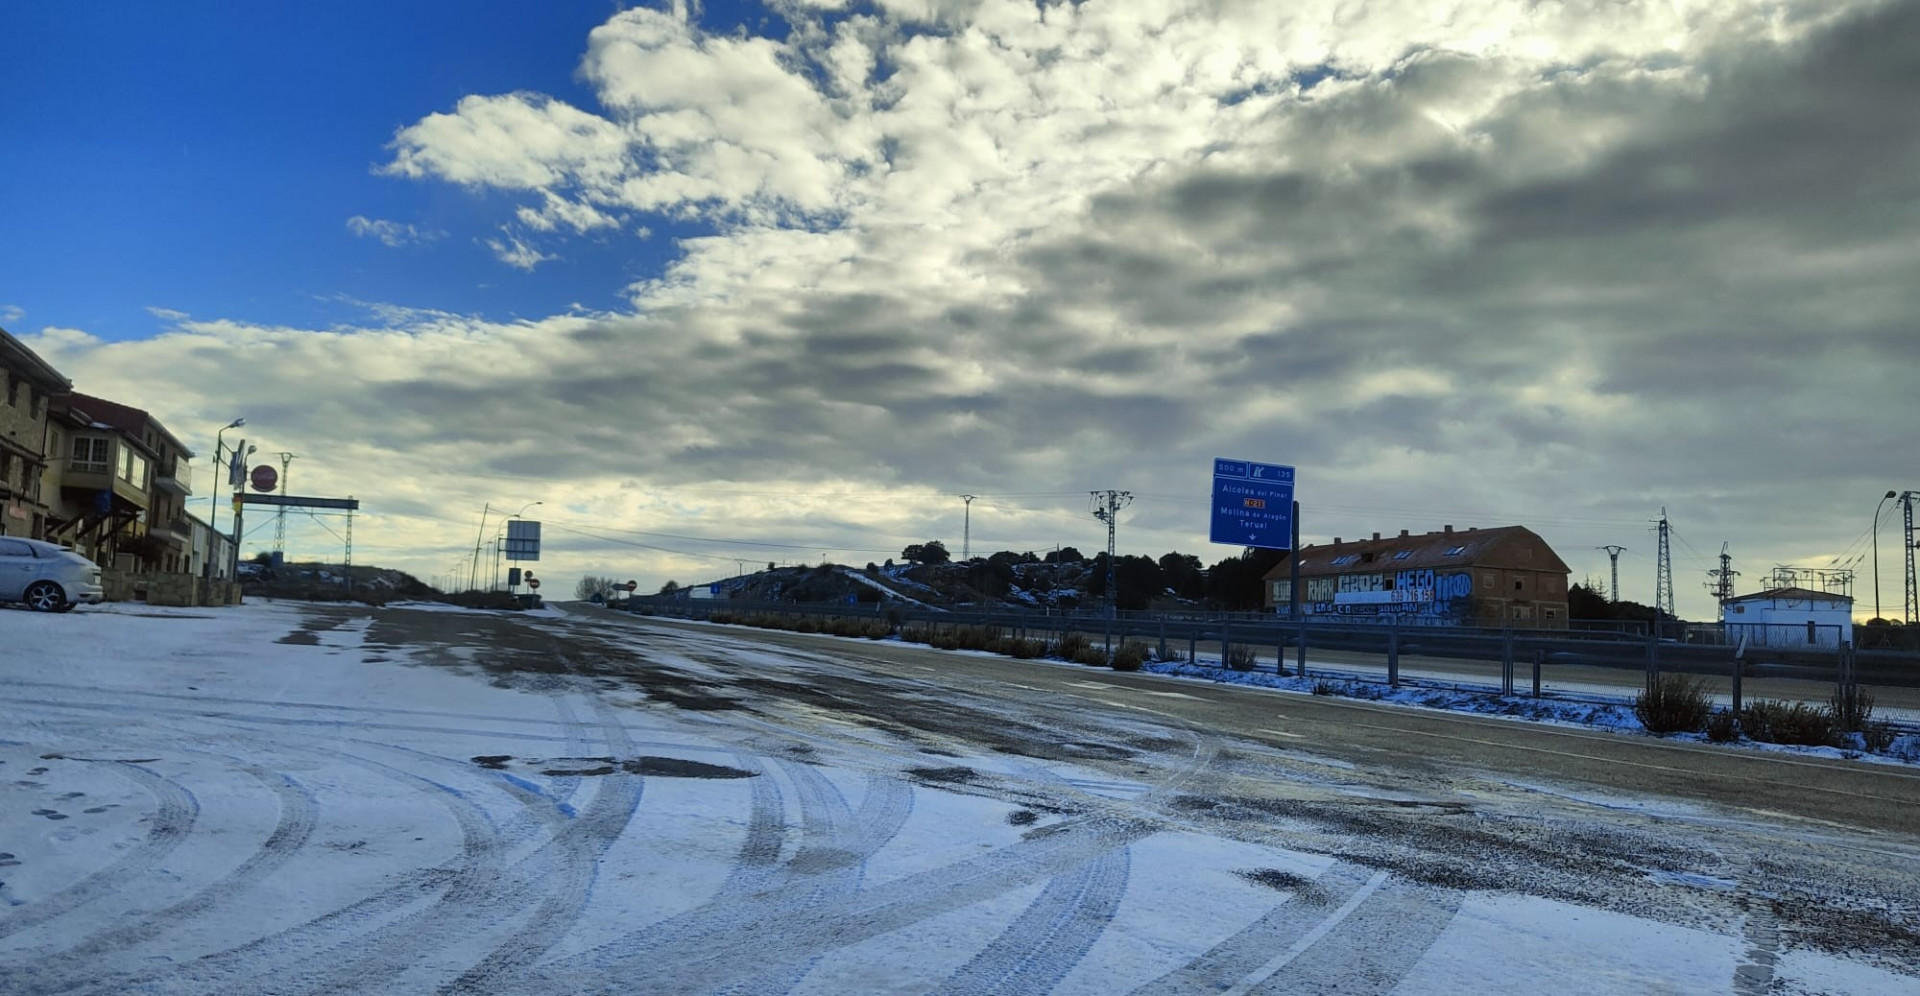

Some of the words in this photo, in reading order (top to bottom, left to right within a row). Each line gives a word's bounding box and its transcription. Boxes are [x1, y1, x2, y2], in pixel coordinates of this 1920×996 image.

[1222, 484, 1255, 495] Alcolea
[1269, 491, 1288, 499] Pinar
[1221, 507, 1250, 517] Molina
[1264, 513, 1287, 521] Aragón
[1240, 519, 1267, 529] Teruel
